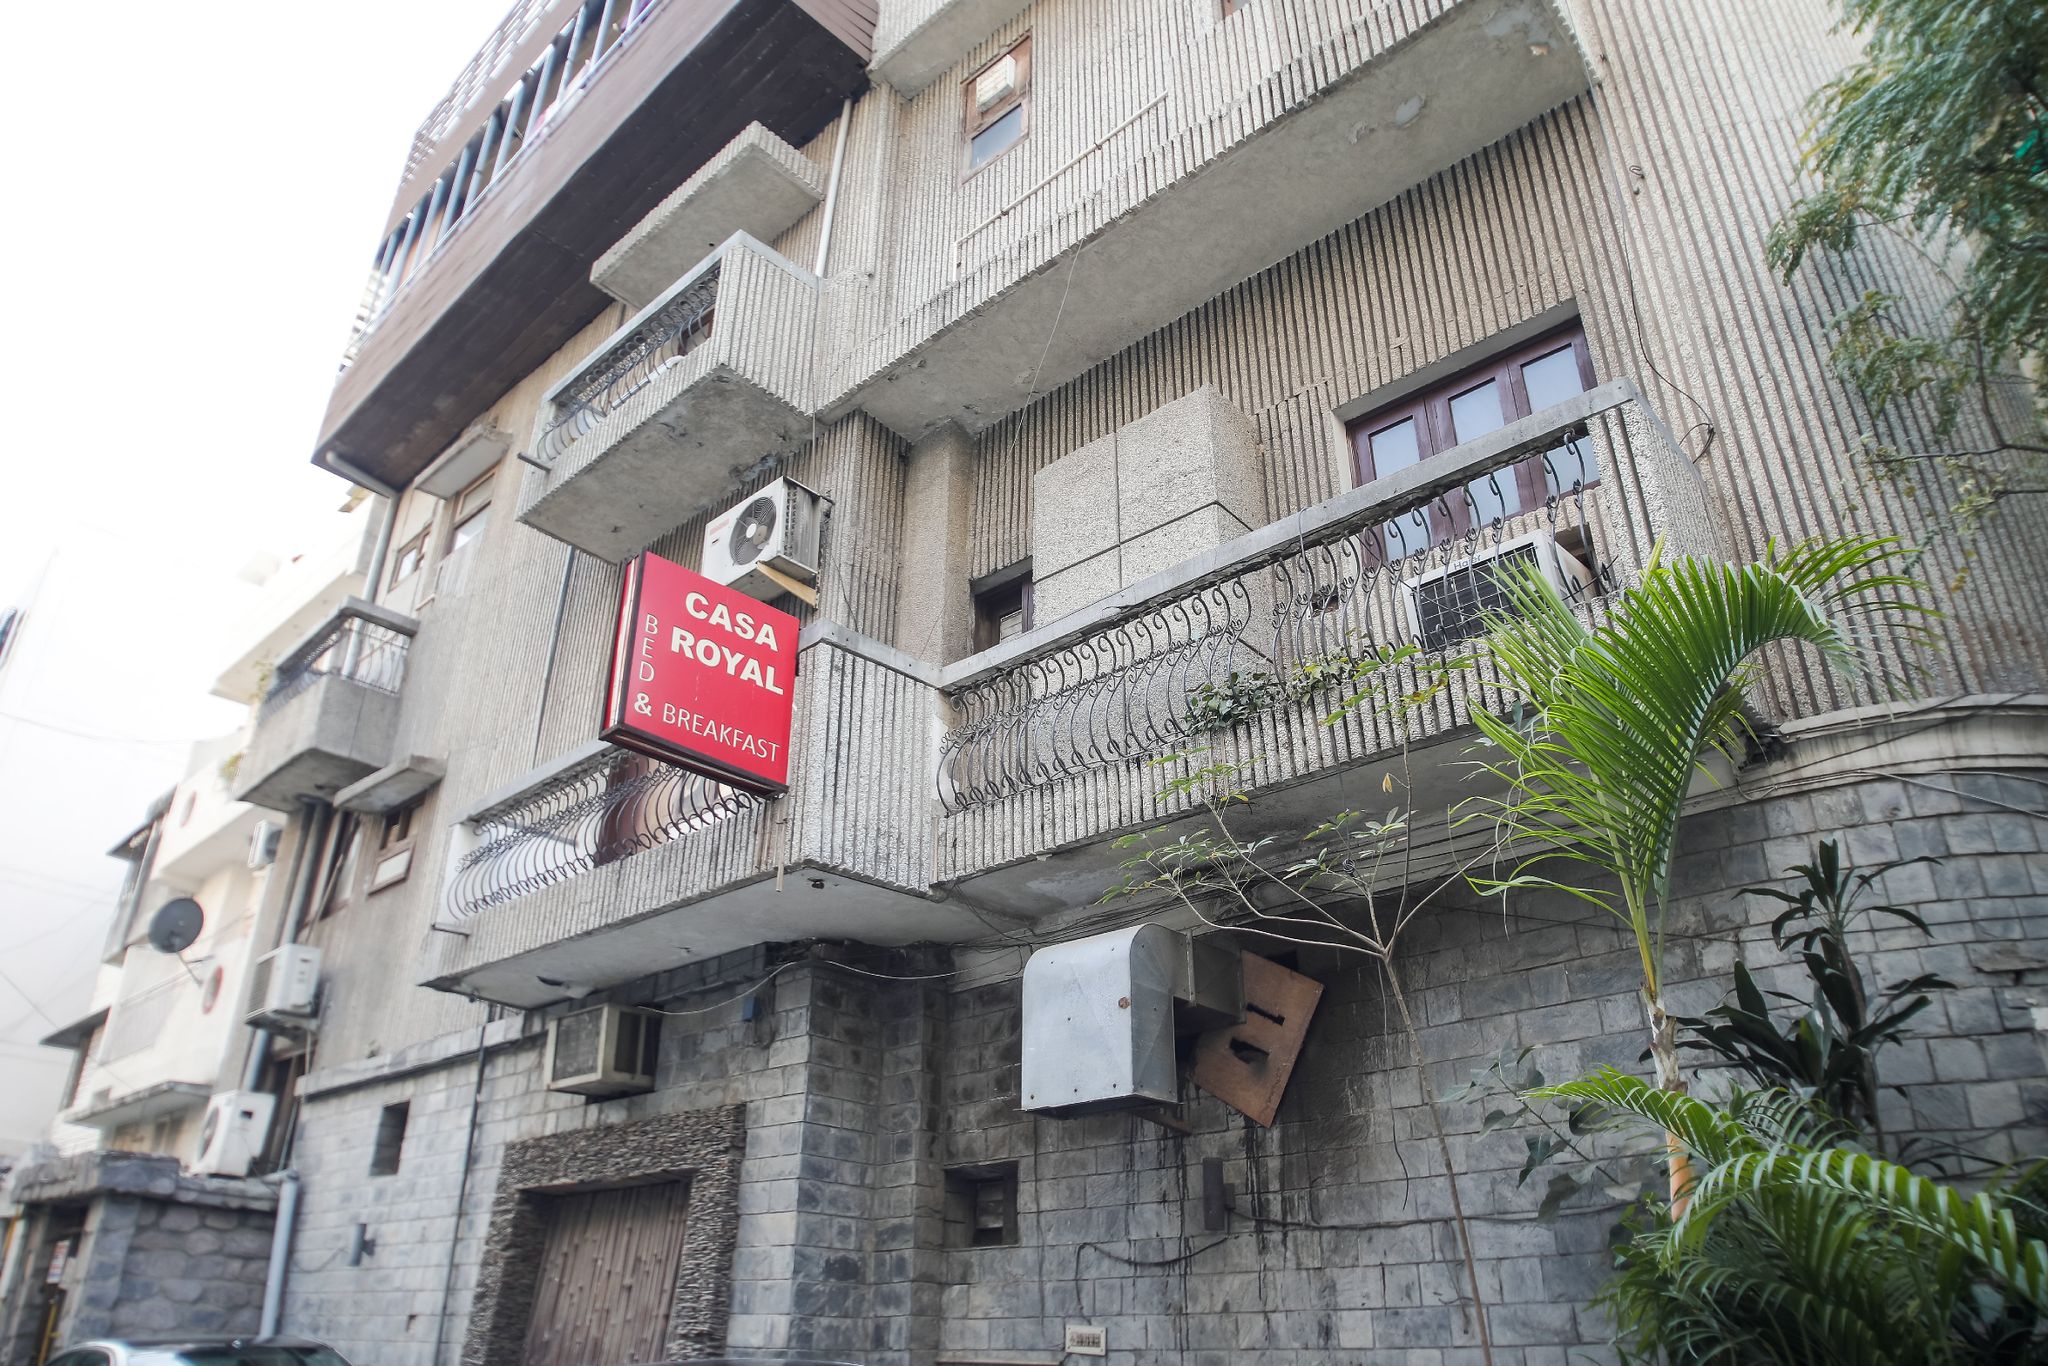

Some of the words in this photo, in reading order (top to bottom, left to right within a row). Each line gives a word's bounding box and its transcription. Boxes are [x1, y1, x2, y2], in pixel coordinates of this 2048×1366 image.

[1453, 554, 1481, 570] Haer
[639, 613, 659, 682] BED
[686, 592, 778, 652] CASA
[671, 626, 784, 695] ROYAL
[634, 692, 653, 717] &
[662, 702, 781, 762] BREAKFAST
